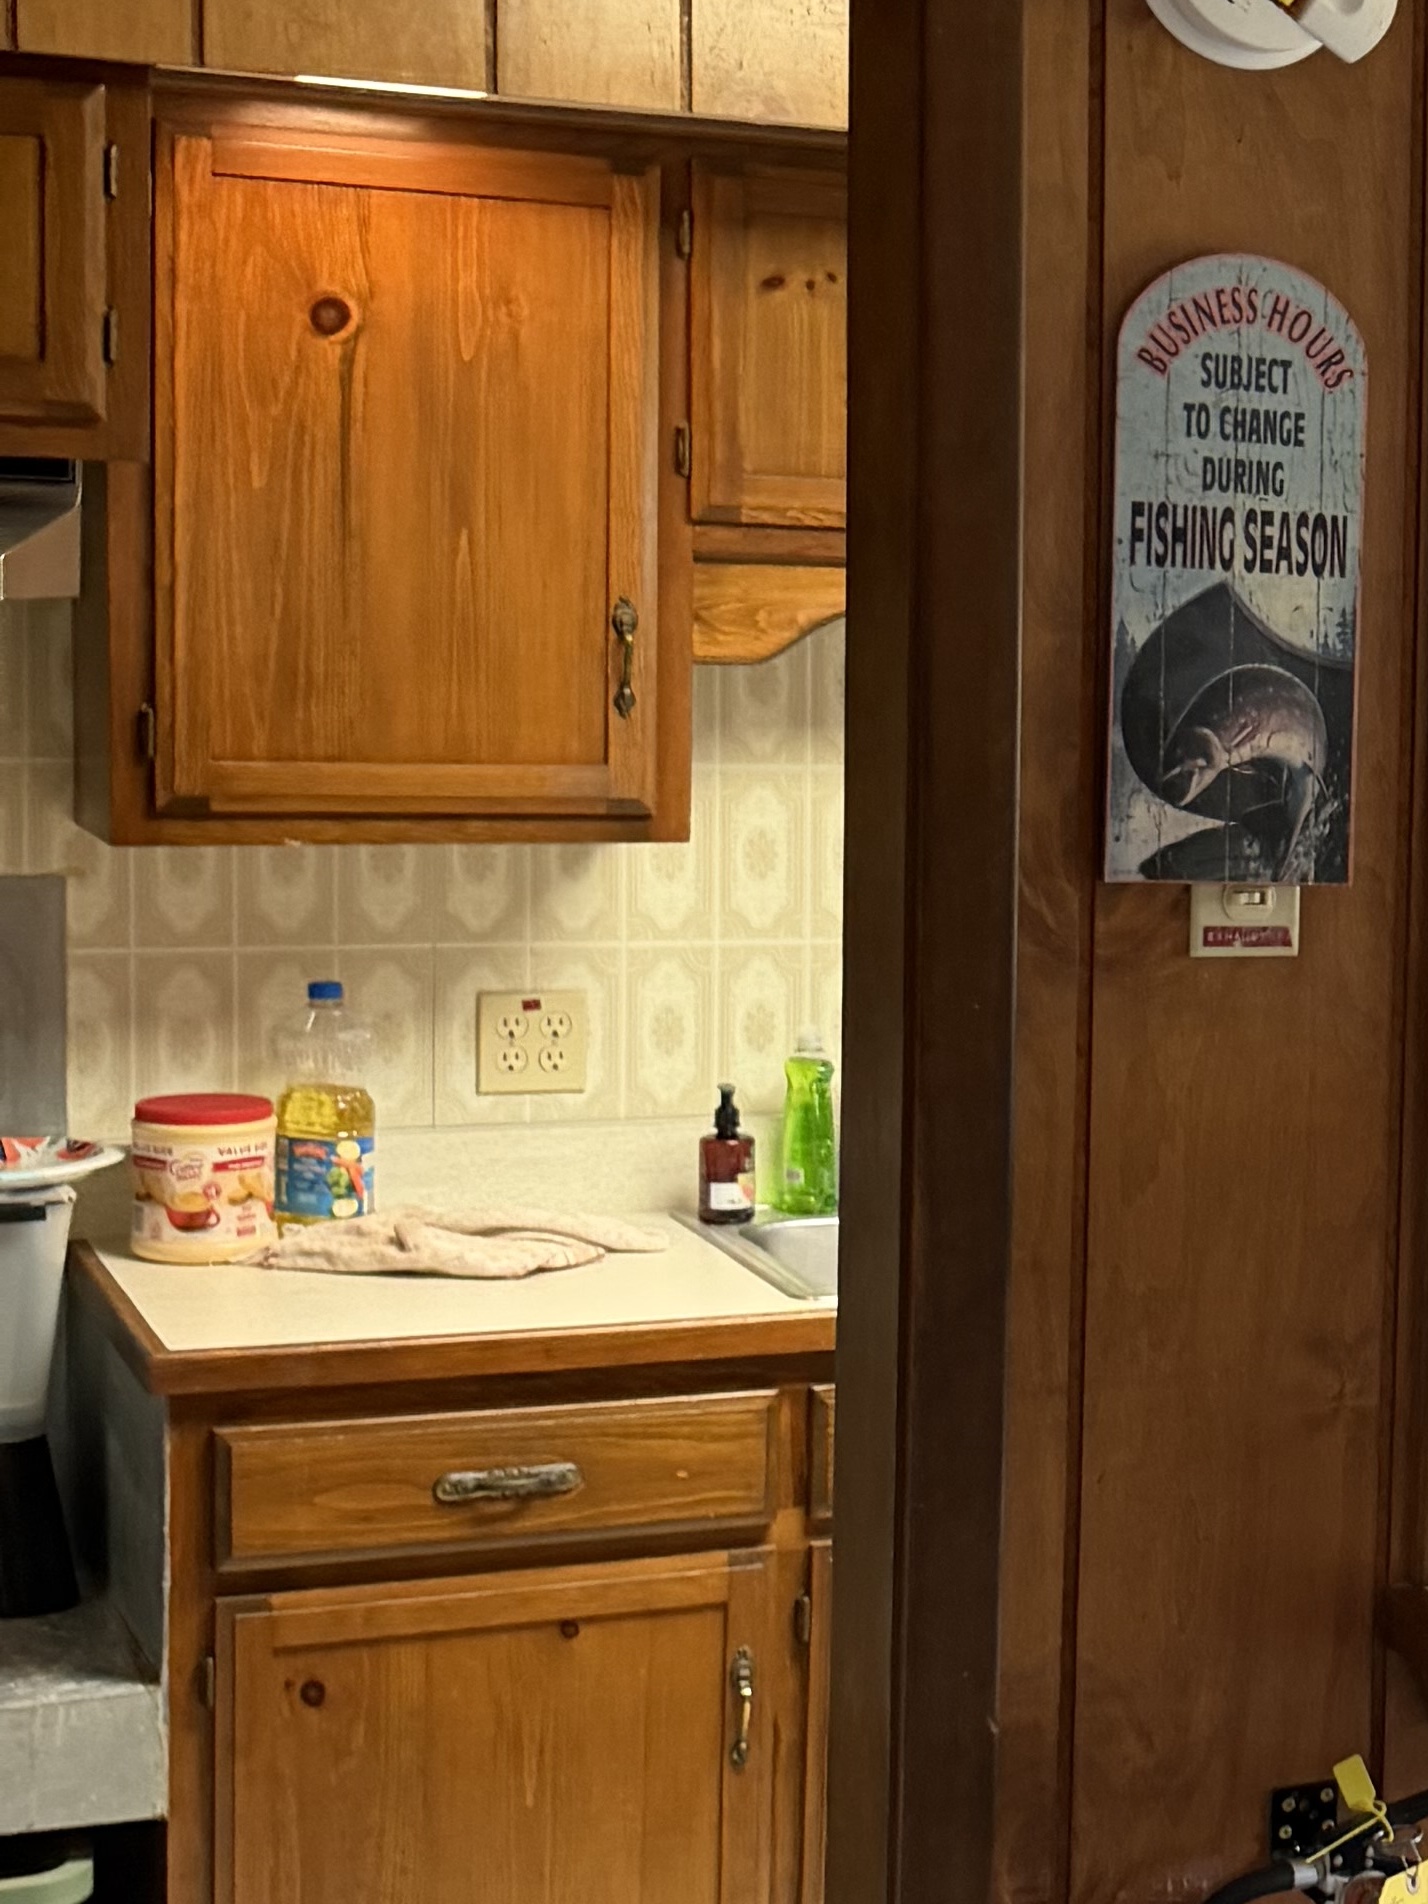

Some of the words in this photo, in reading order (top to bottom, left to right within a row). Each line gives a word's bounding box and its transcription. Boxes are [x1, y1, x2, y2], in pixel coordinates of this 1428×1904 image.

[1136, 286, 1258, 375] BUSINESS
[1267, 294, 1354, 389] HOURS
[1201, 352, 1292, 394] SUBJECT
[1183, 402, 1211, 440] TO
[1219, 405, 1306, 447] CHANGE
[1202, 456, 1285, 497] DURING
[1129, 501, 1235, 572] FISHING
[1243, 507, 1348, 578] SEASON
